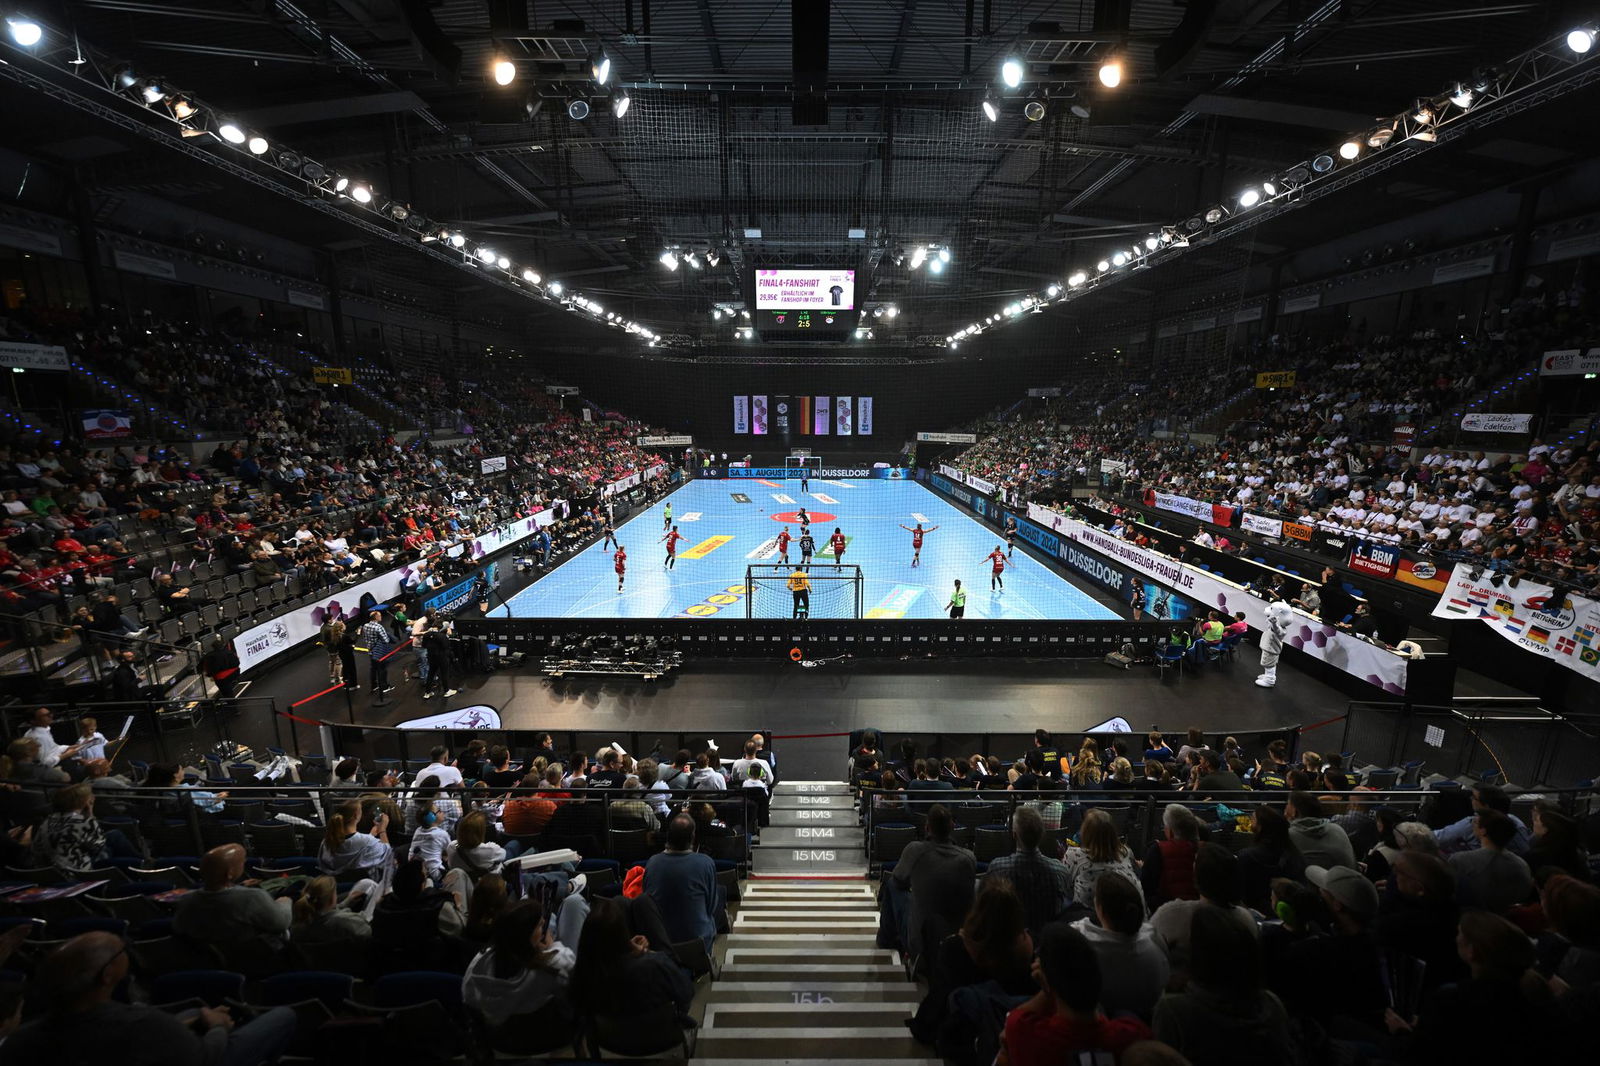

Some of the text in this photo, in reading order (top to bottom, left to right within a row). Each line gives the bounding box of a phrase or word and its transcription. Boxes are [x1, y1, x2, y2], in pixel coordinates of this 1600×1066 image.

[760, 293, 778, 301] 29,95€
[798, 320, 811, 328] 2:5
[1483, 422, 1517, 431] Edelfans
[822, 469, 870, 477] DÜSSELDORF
[1082, 530, 1195, 589] WWW.HANDBALL-BUNDESLIGA-FRAUEN.DE
[1355, 545, 1394, 566] S BBM
[1041, 533, 1058, 553] 2024
[1060, 543, 1067, 560] IN
[1068, 547, 1123, 590] DÜSSELDORF
[1354, 558, 1391, 573] BIETIGHEIM
[1457, 581, 1475, 590] LADY
[1531, 611, 1565, 628] BIETIGHEIM
[799, 796, 830, 804] 15 M2
[799, 810, 832, 819] 15 M3
[797, 828, 833, 837] 15 M4
[794, 850, 835, 861] 15 M5
[791, 992, 813, 1004] 15
